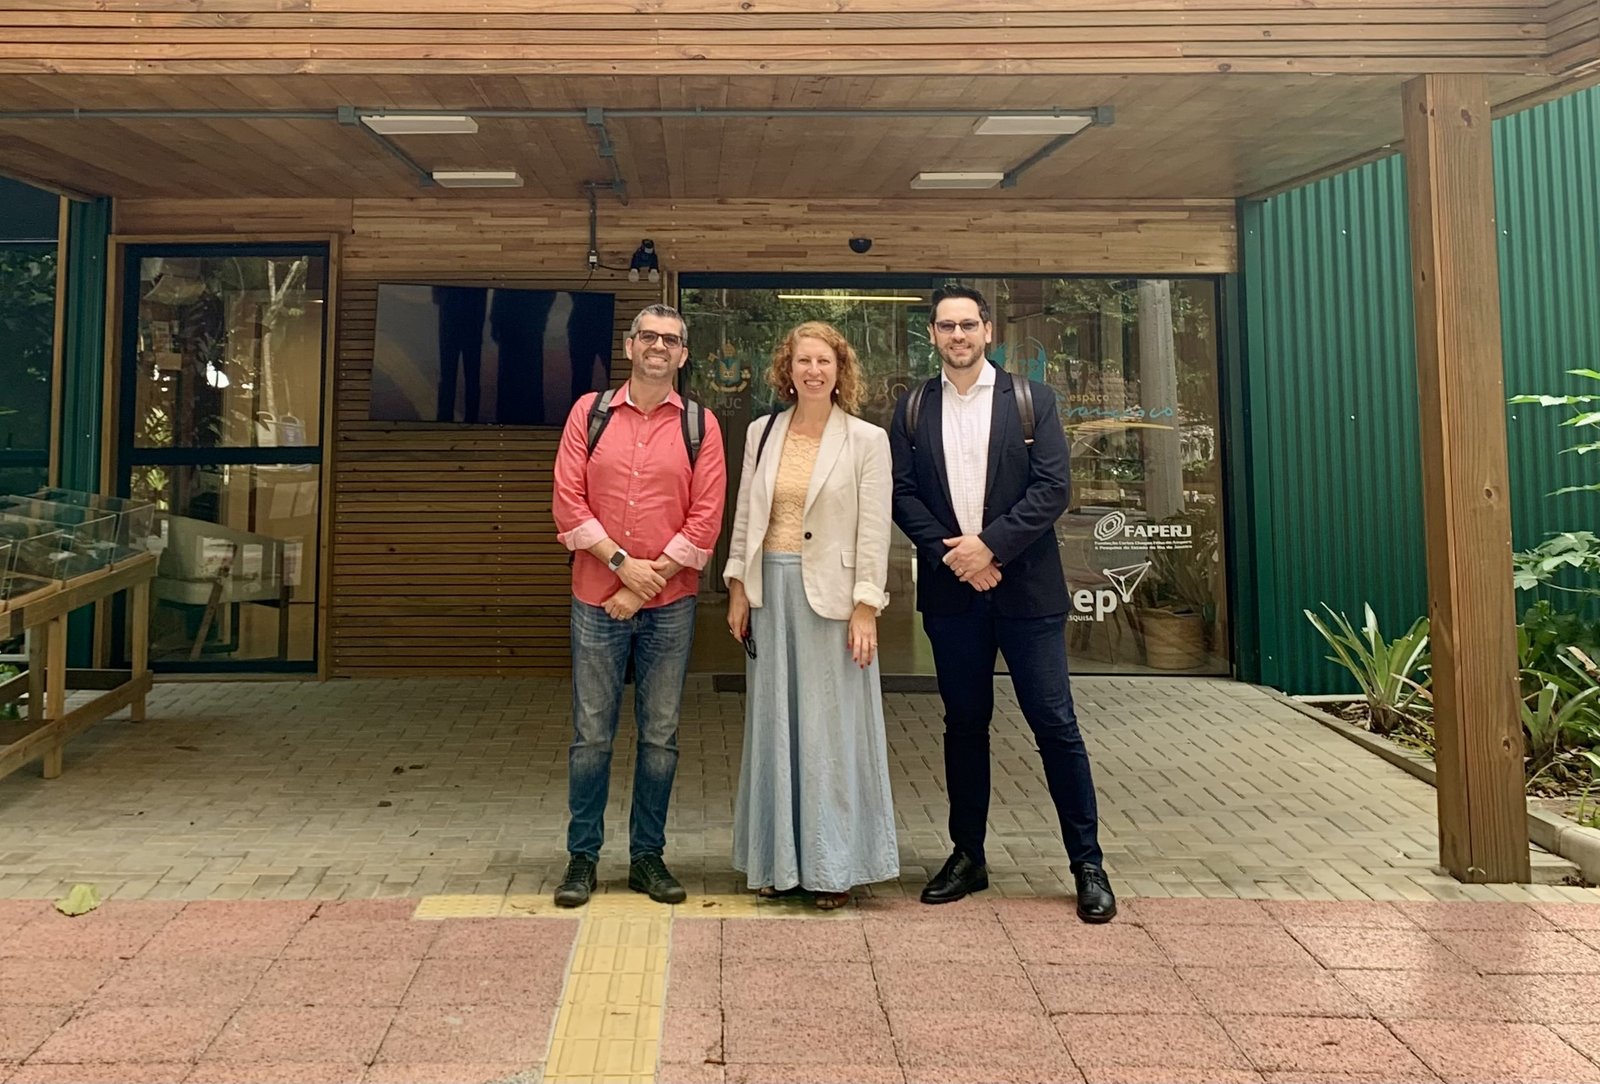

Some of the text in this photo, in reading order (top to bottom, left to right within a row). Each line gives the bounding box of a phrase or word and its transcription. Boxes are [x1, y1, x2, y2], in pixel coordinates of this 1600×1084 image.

[1069, 393, 1109, 404] espaço
[1124, 525, 1192, 538] FAPERJ
[1069, 589, 1118, 622] ep
